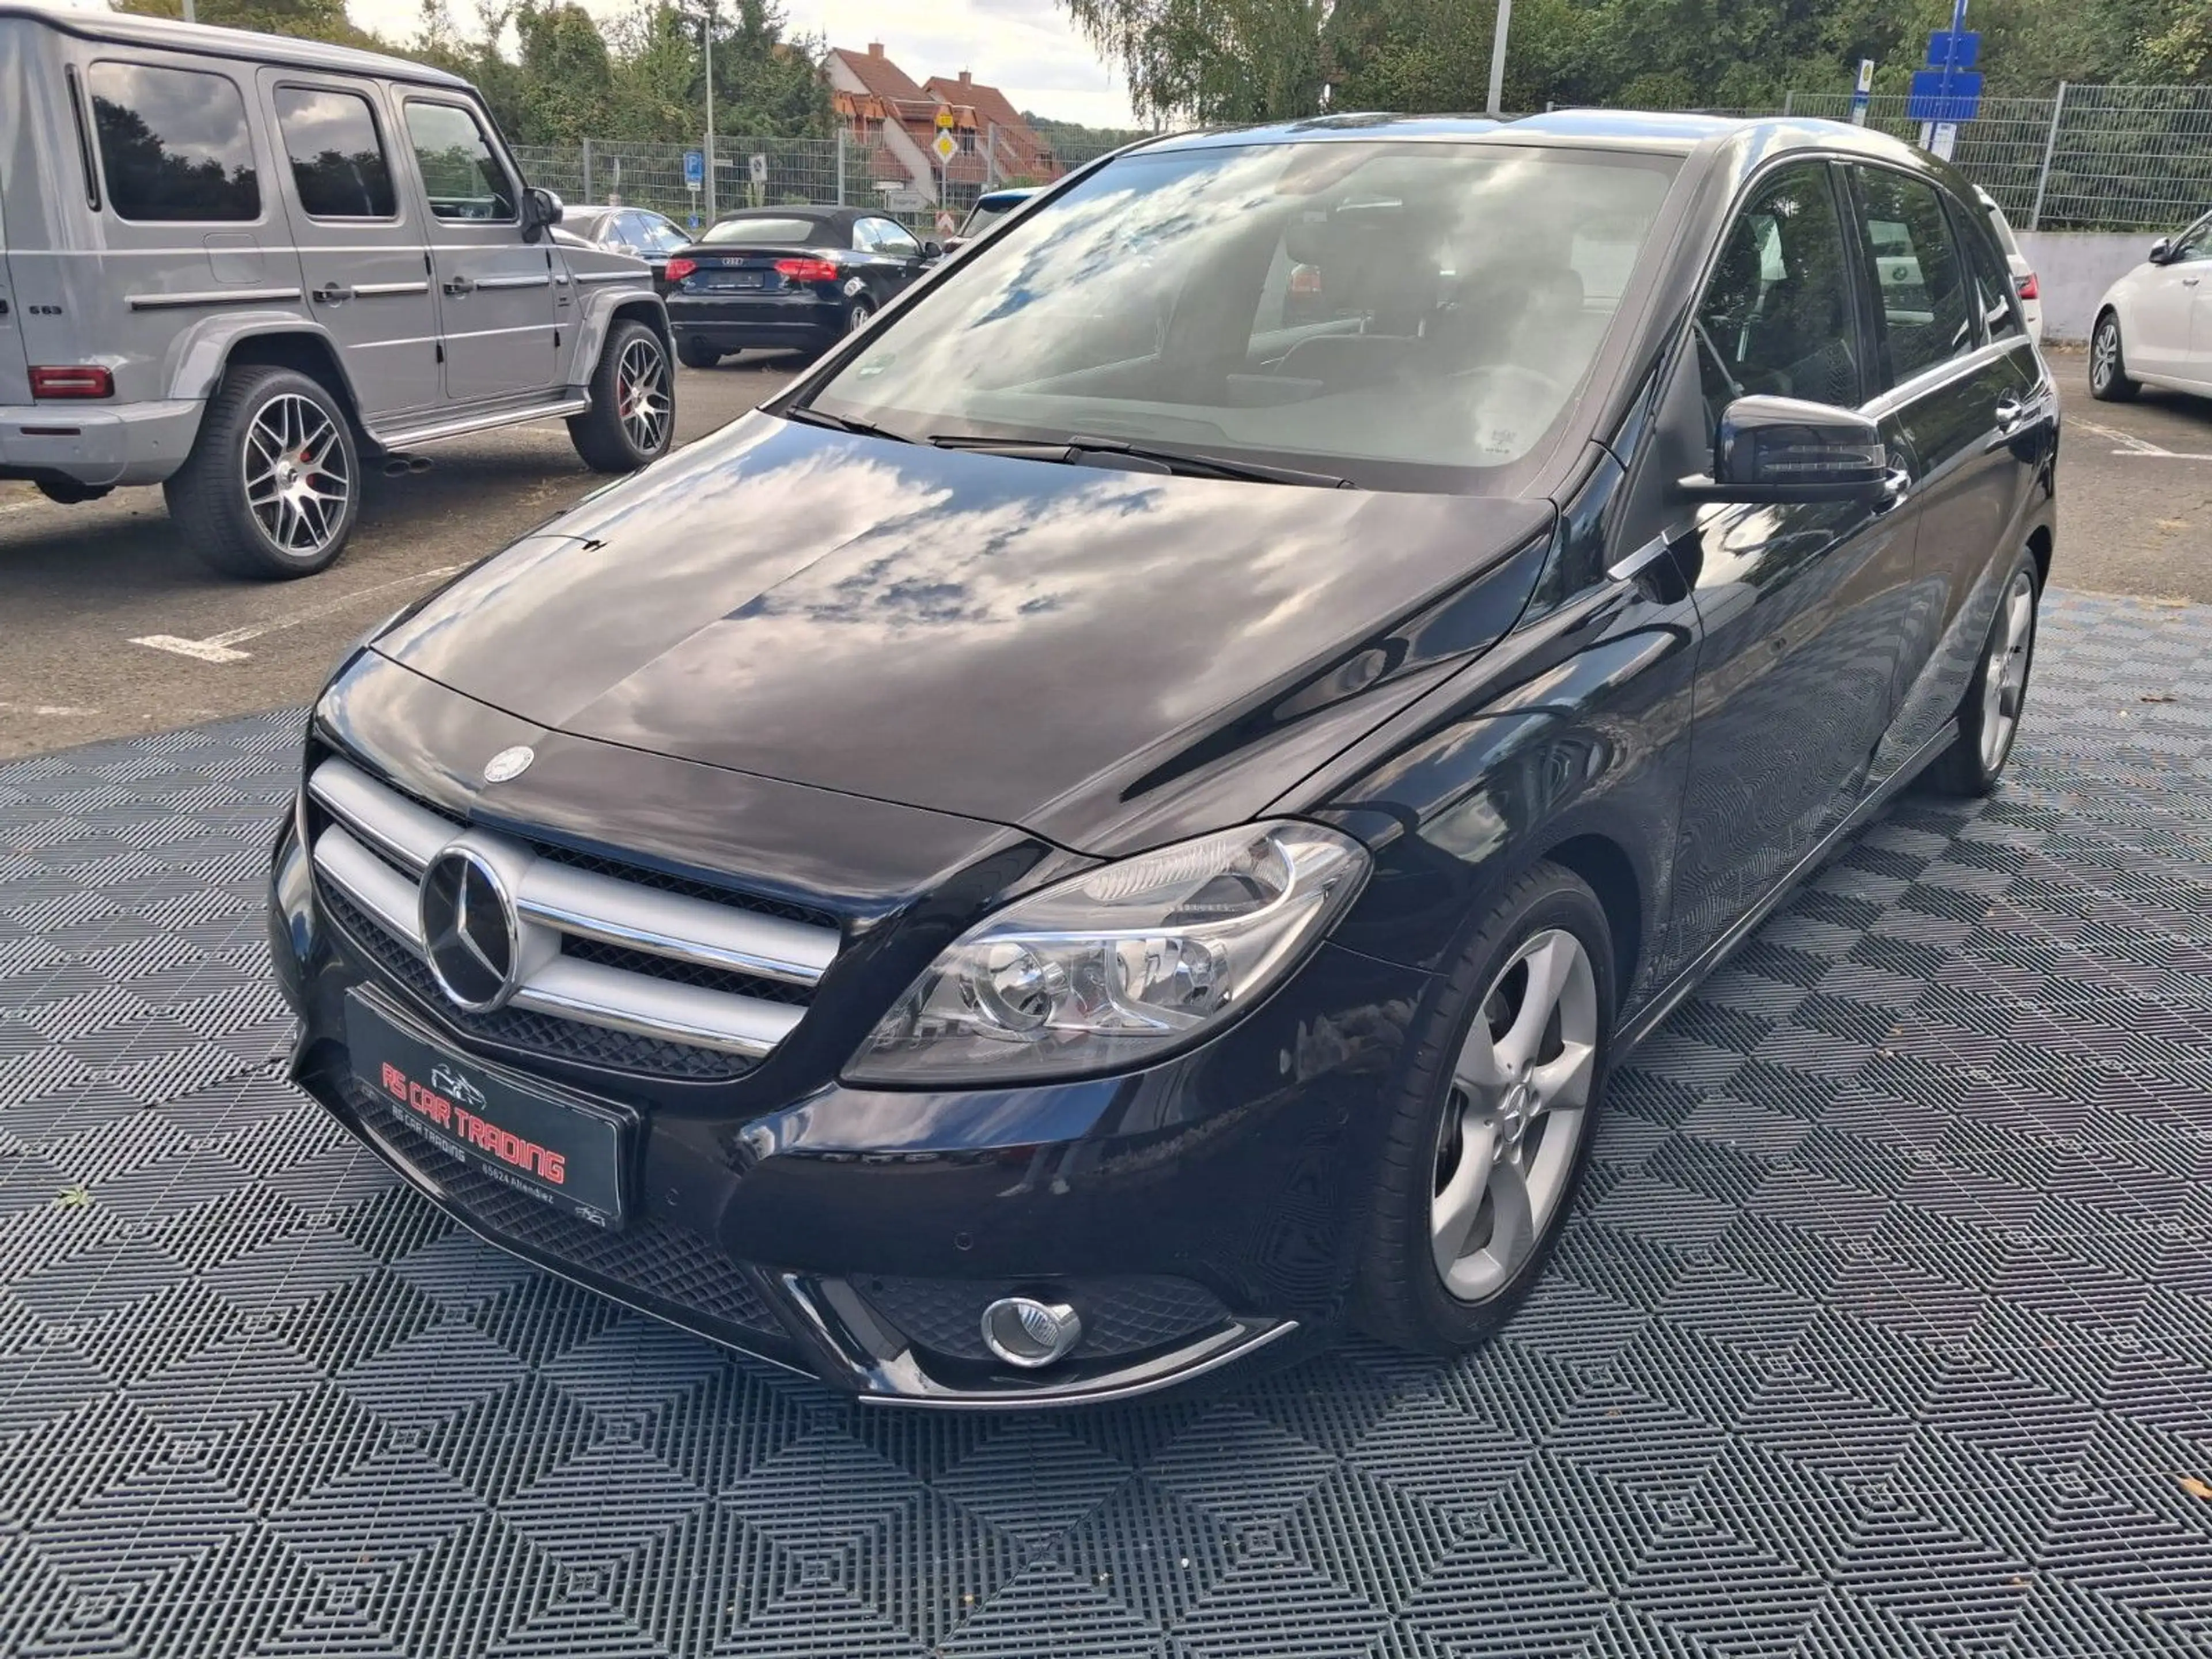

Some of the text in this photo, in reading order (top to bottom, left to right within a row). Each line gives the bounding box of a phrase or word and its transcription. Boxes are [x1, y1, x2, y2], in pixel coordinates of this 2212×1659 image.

[405, 1114, 423, 1134] CAR
[424, 1128, 465, 1162] TRADING
[410, 1080, 450, 1129] CAR
[454, 1107, 565, 1184] TRADING
